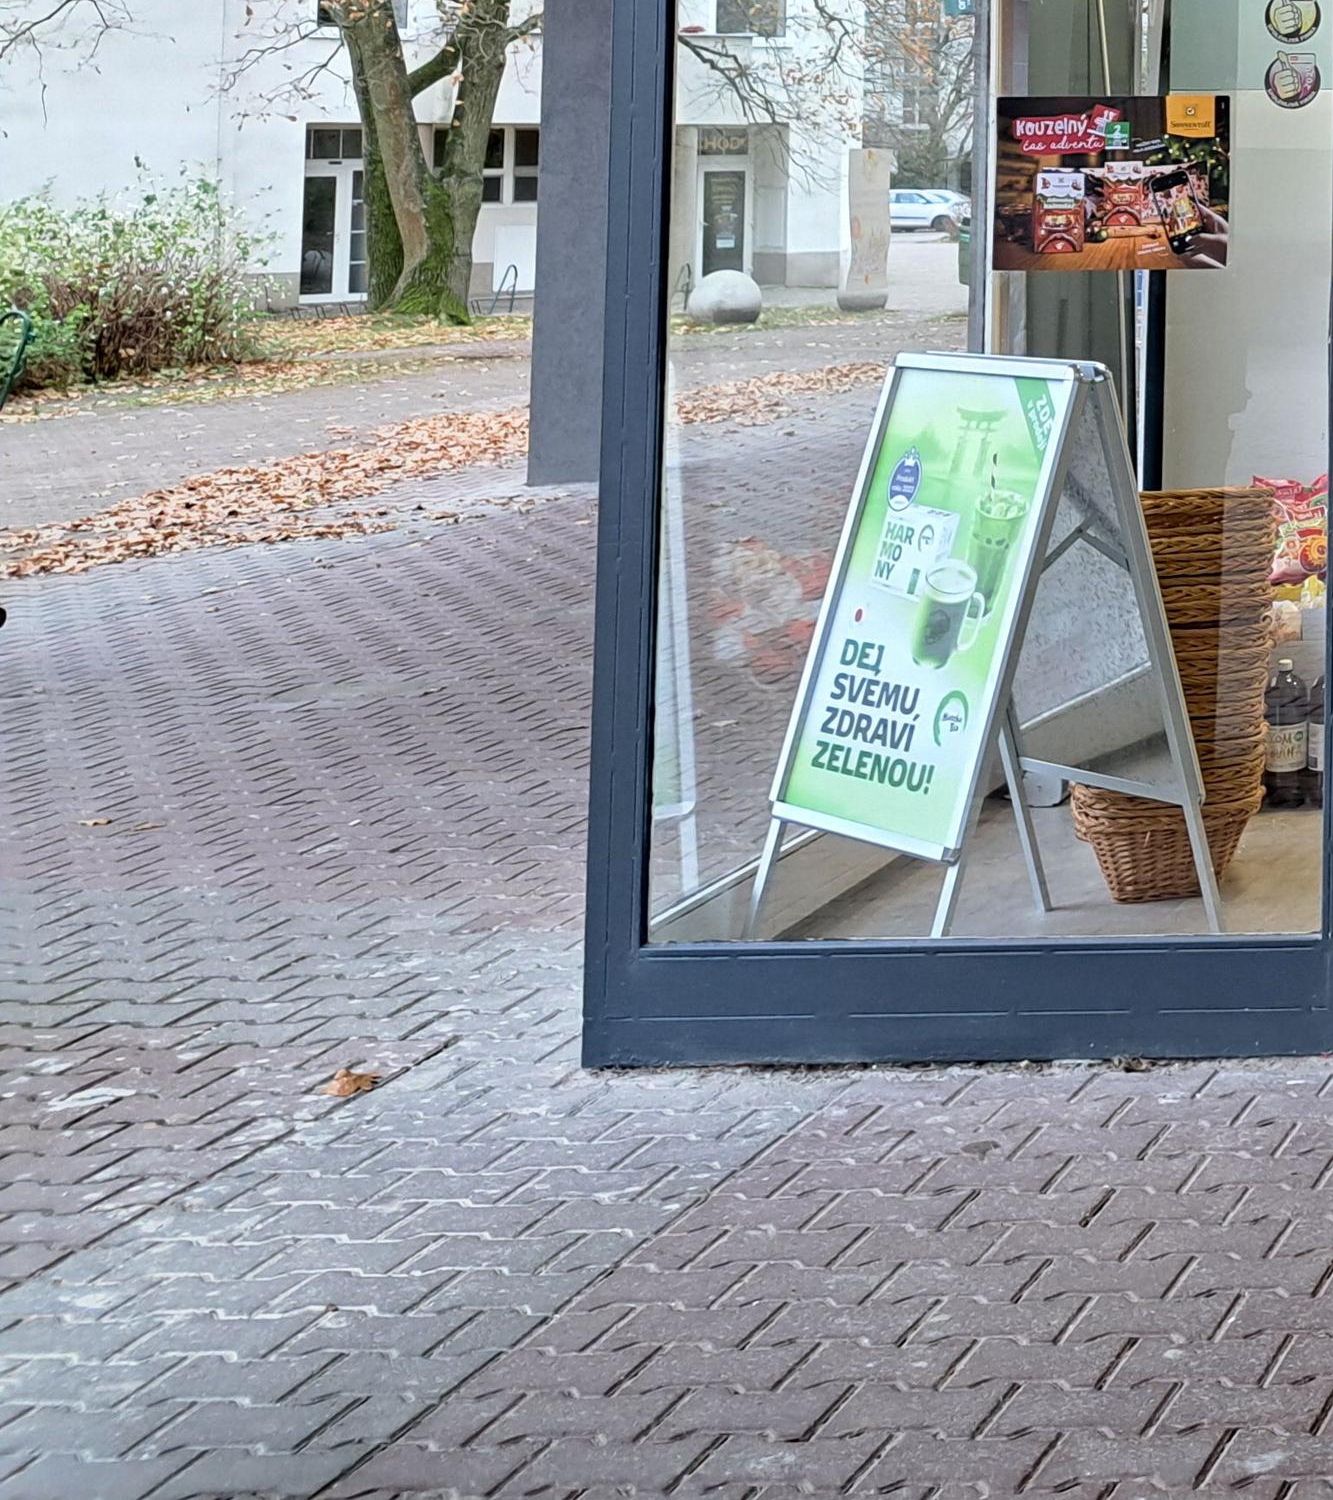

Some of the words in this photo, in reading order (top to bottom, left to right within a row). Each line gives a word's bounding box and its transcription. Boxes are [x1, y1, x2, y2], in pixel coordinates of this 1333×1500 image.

[1036, 393, 1053, 436] ZDE
[840, 638, 885, 672] DEJ
[820, 706, 920, 752] ZDRAVÍ
[811, 740, 935, 795] ZELENOU!
